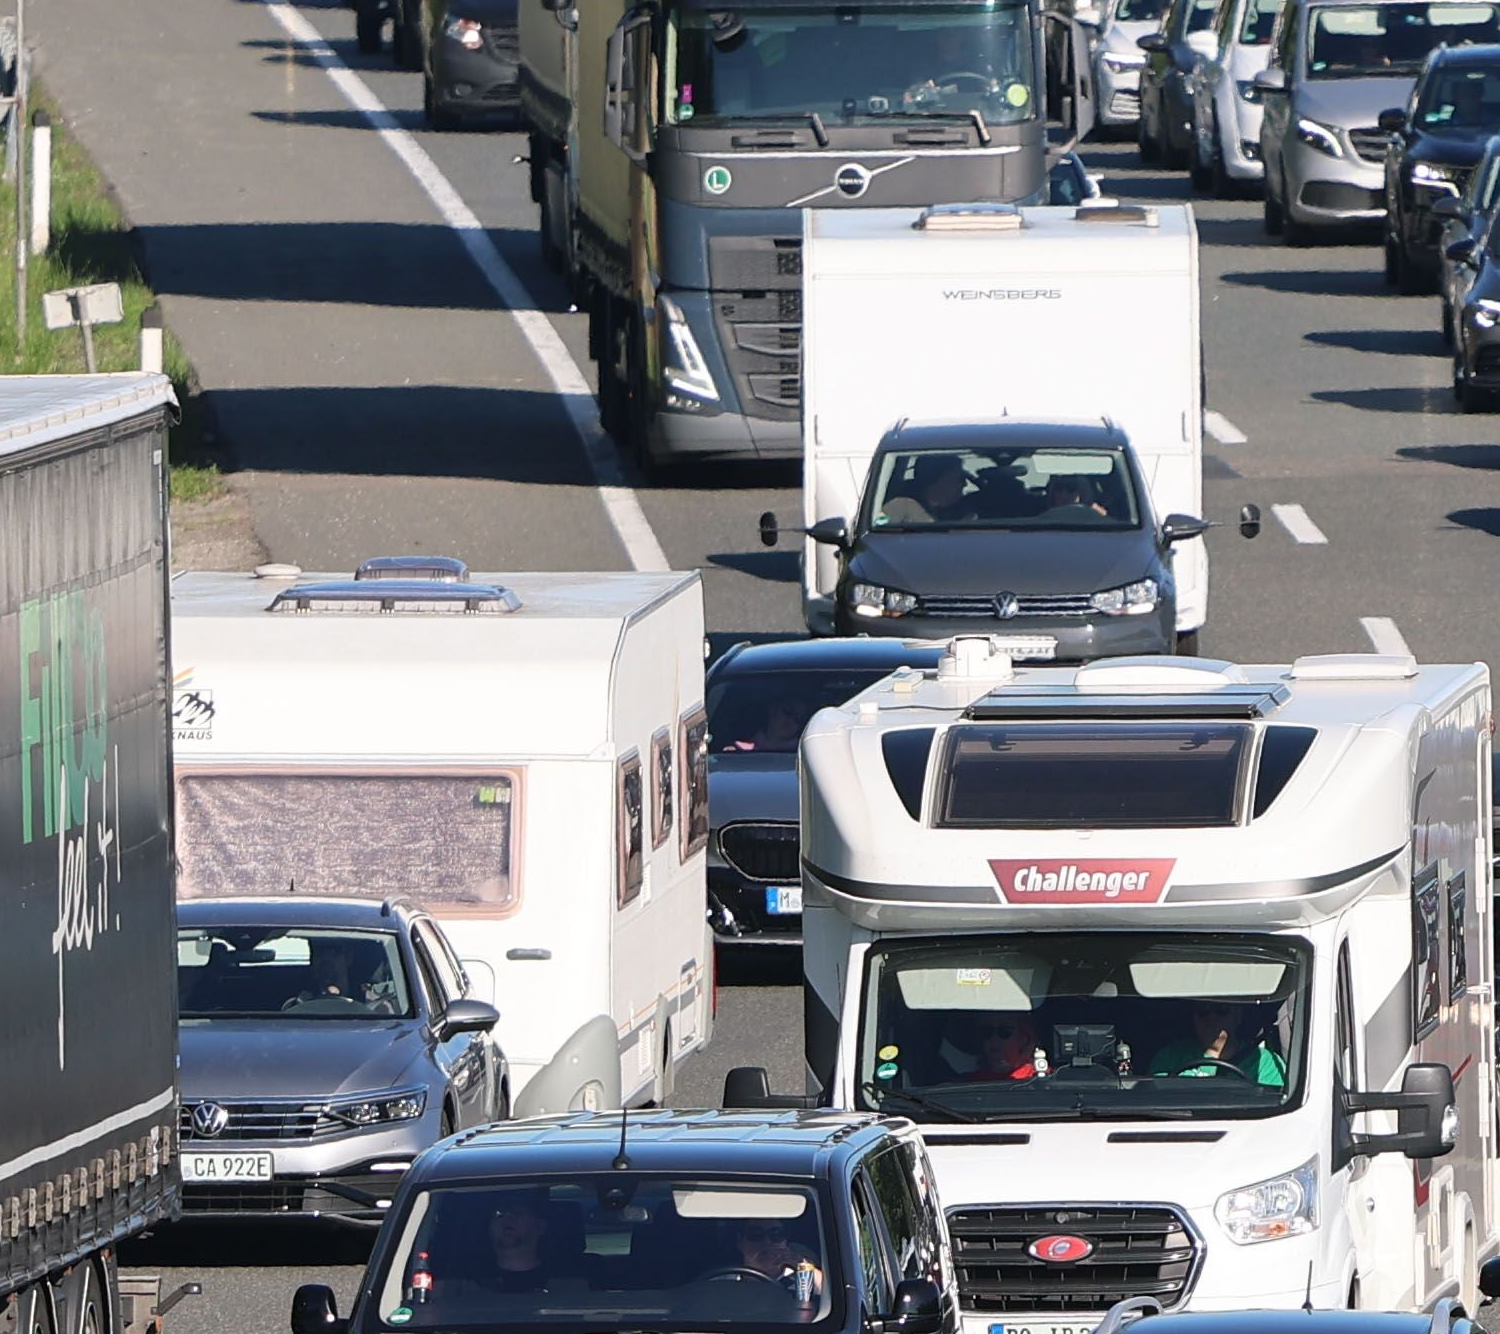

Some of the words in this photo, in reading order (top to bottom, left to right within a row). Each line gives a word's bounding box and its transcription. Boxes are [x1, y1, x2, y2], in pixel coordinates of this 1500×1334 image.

[712, 171, 725, 189] L
[942, 289, 1062, 301] WEINSBERG
[1013, 865, 1151, 898] Challenger
[194, 1157, 217, 1177] CA
[223, 1157, 269, 1177] 922E
